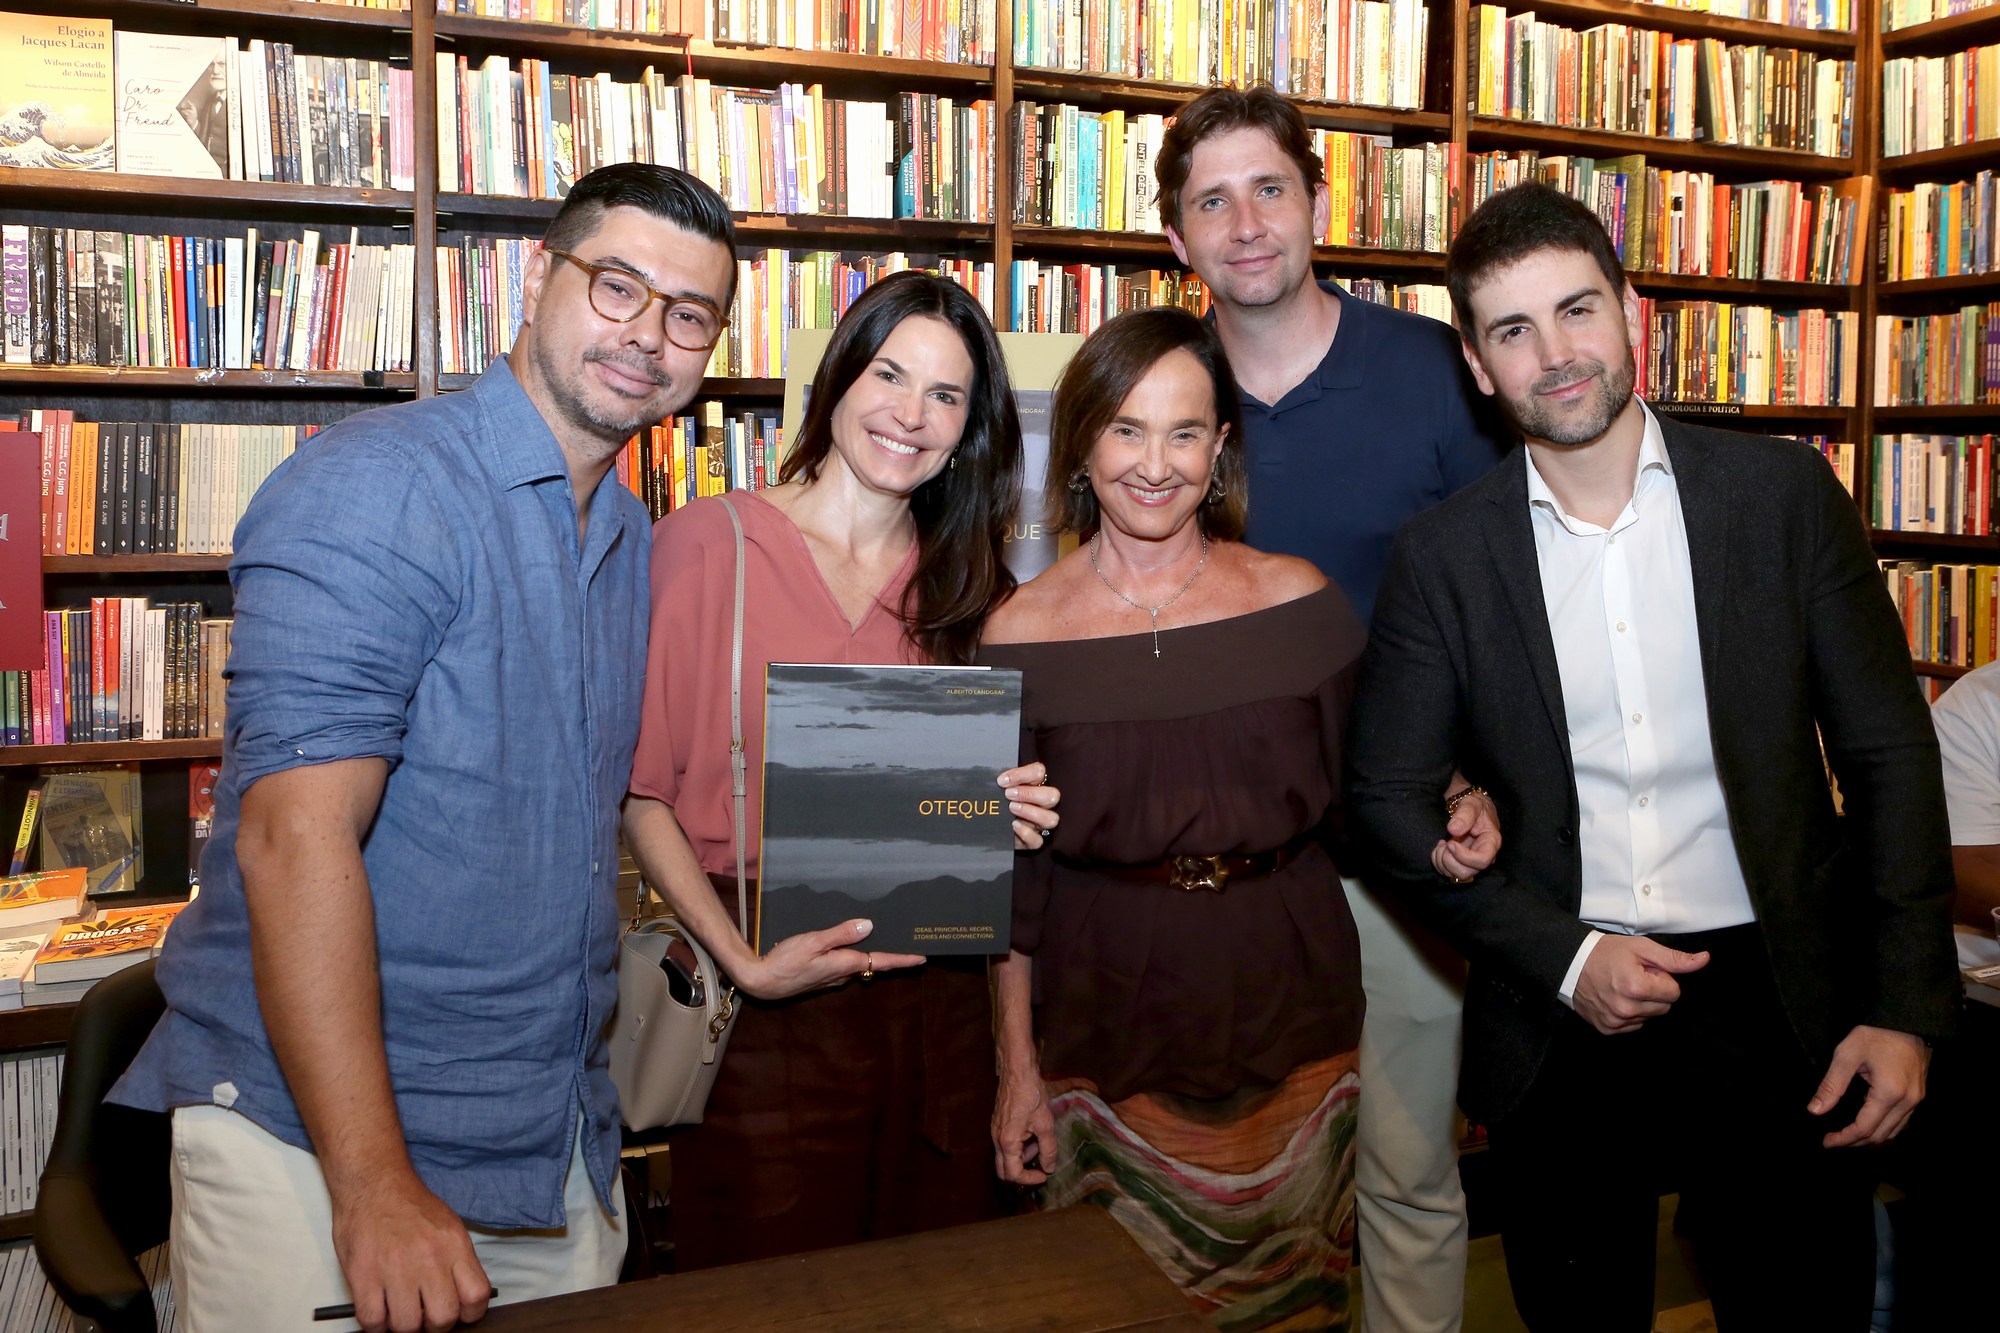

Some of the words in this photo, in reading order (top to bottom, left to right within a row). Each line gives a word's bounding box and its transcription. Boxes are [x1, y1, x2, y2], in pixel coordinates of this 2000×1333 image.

[58, 26, 96, 38] Elogio
[98, 30, 104, 38] a
[22, 35, 66, 48] Jacques
[71, 38, 104, 50] Lacan
[44, 58, 72, 67] Wilson
[74, 60, 105, 69] Castello
[62, 69, 71, 77] de
[74, 70, 106, 79] Almeida
[125, 79, 164, 96] Caro
[124, 96, 148, 111] Dr.
[123, 111, 174, 128] Freud
[328, 248, 336, 270] FREUD
[4, 239, 28, 314] FREUD
[296, 294, 310, 330] Freud
[1708, 405, 1740, 413] POLÍTICA
[43, 462, 51, 477] C.G.
[59, 461, 67, 476] C.G.
[56, 478, 65, 495] Jung
[1003, 524, 1040, 543] QUE
[918, 800, 1000, 819] OTEQUE
[62, 925, 147, 942] DROGAS
